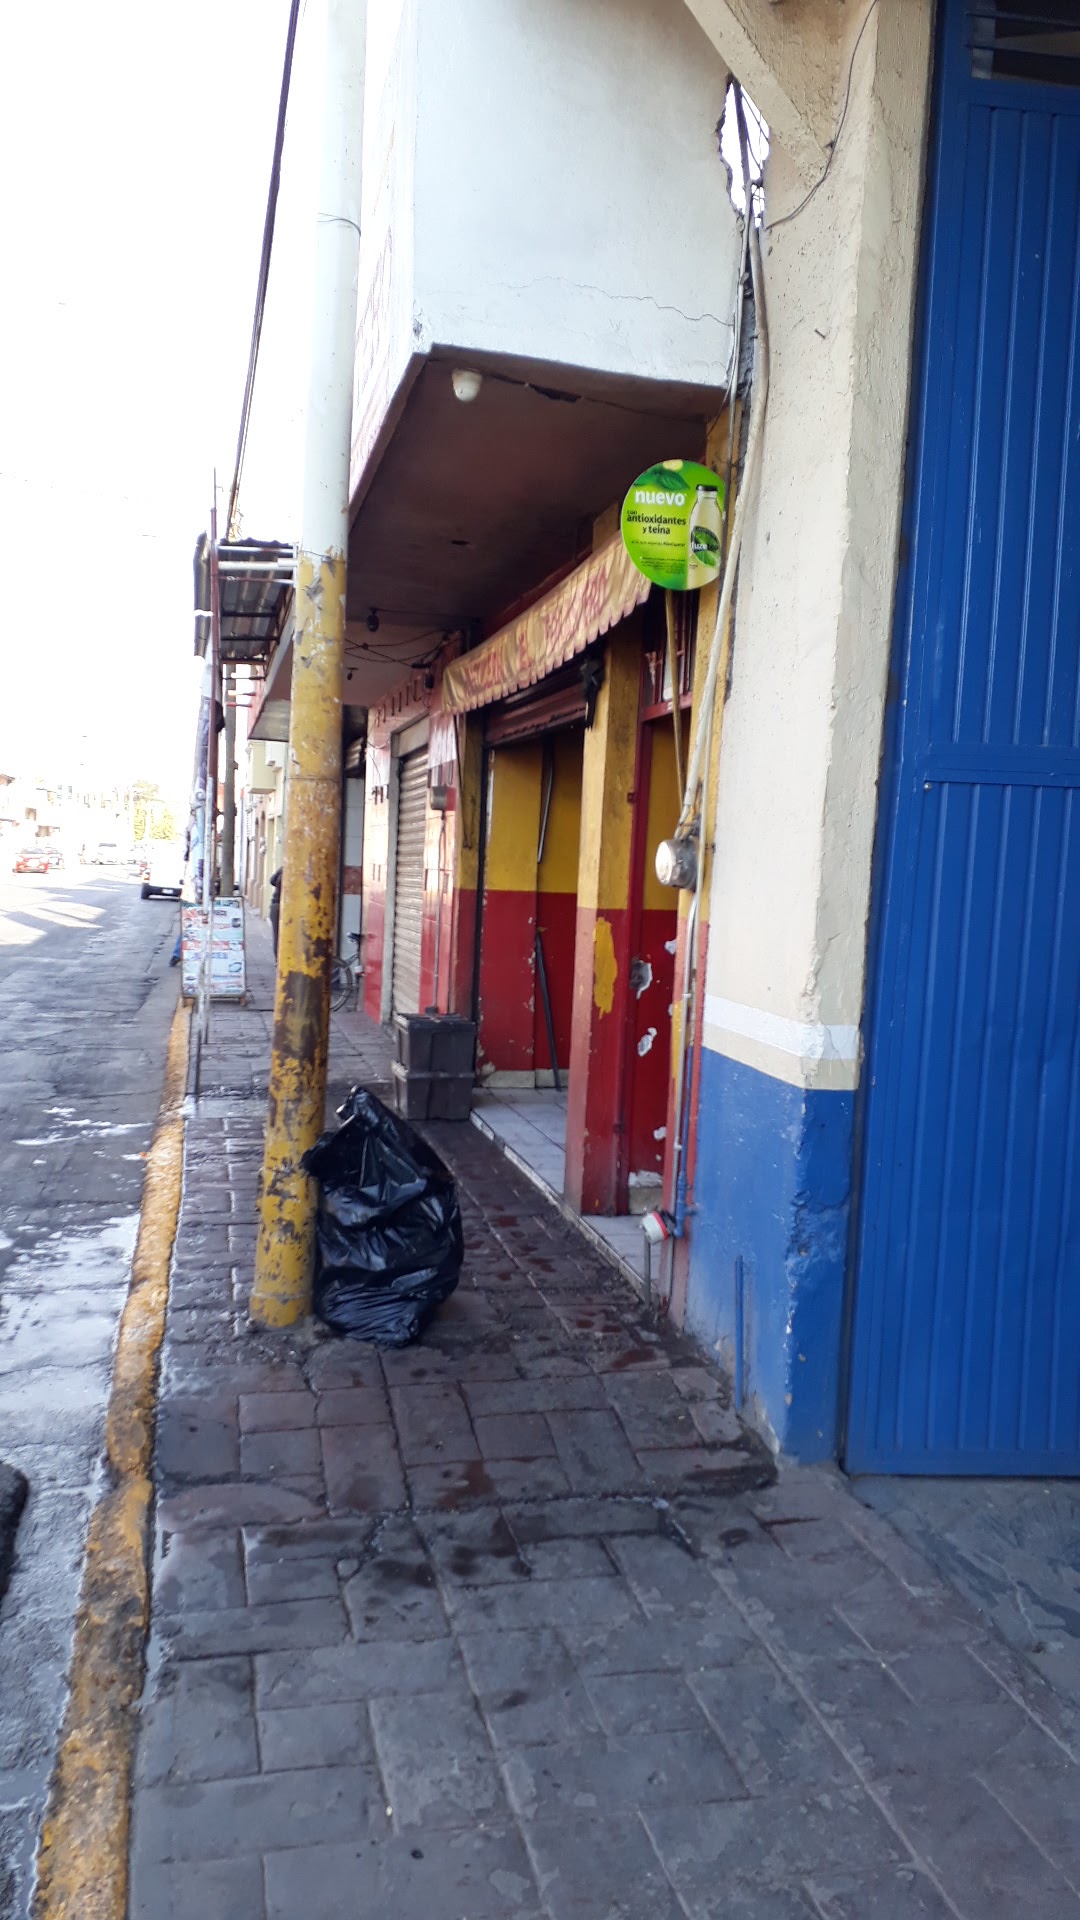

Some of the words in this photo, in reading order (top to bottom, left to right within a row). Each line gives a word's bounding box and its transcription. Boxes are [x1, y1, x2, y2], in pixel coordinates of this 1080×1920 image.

[635, 490, 684, 505] nuevo
[627, 513, 686, 525] antioxidantes
[642, 526, 647, 534] y
